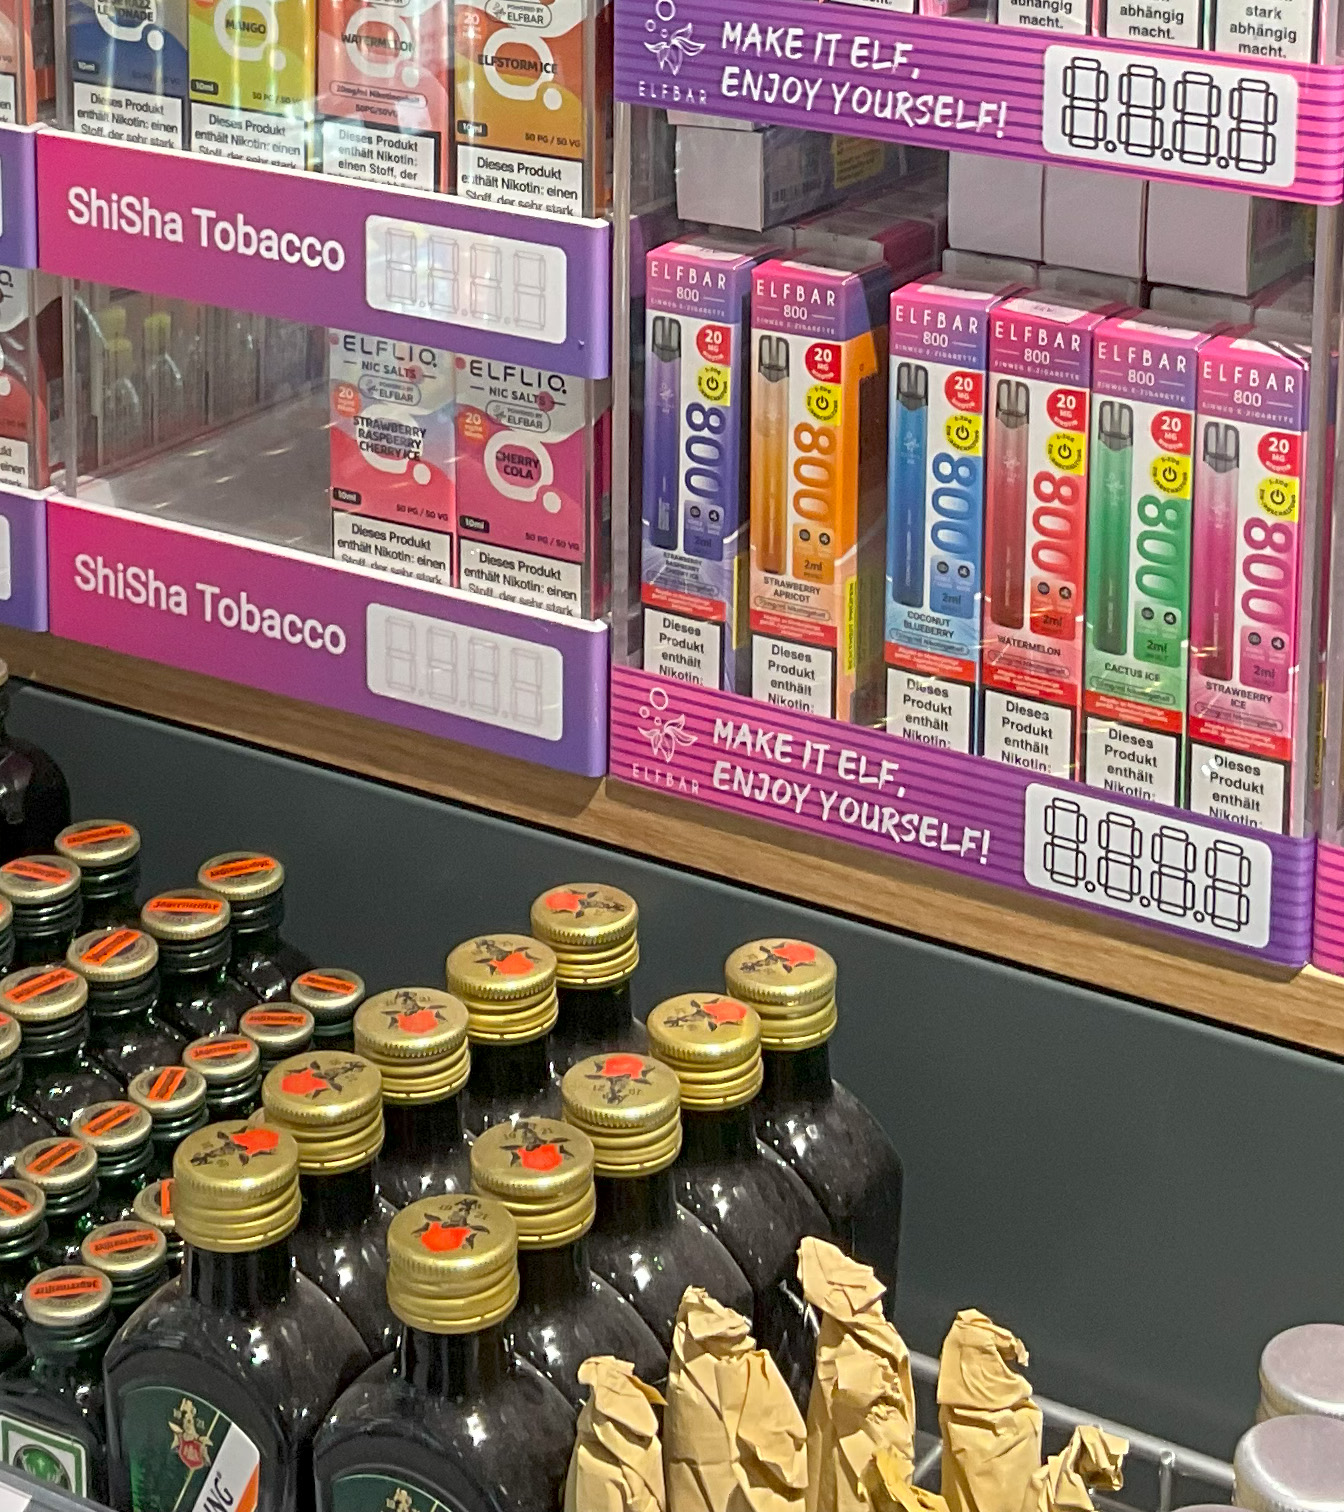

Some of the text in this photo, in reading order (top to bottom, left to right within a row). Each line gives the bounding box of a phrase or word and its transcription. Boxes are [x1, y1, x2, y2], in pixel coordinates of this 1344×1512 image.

[225, 18, 267, 35] MANGO
[721, 20, 921, 81] MAKE IT ELF,
[478, 54, 557, 75] ELFSTORM ICE
[639, 81, 707, 106] ELFBAR
[721, 66, 1007, 138] ENJOY YOURSELF!
[477, 157, 562, 181] Dieses Produkt
[67, 186, 346, 273] ShiSha Tobacco
[470, 358, 567, 395] ELFLIQ
[353, 414, 427, 439] STRAWBERRY
[358, 428, 423, 451] RASPBERRY
[496, 449, 540, 469] CHERRY
[503, 463, 534, 480] COLA
[764, 576, 821, 596] STRAWBERRY
[773, 588, 811, 603] APRICOT
[74, 553, 347, 656] ShiSha Tobacco
[1104, 661, 1160, 683] CACTUS ICE
[712, 717, 906, 798] MAKE IT ELF,
[712, 763, 991, 866] ENJOY YOURSELF!
